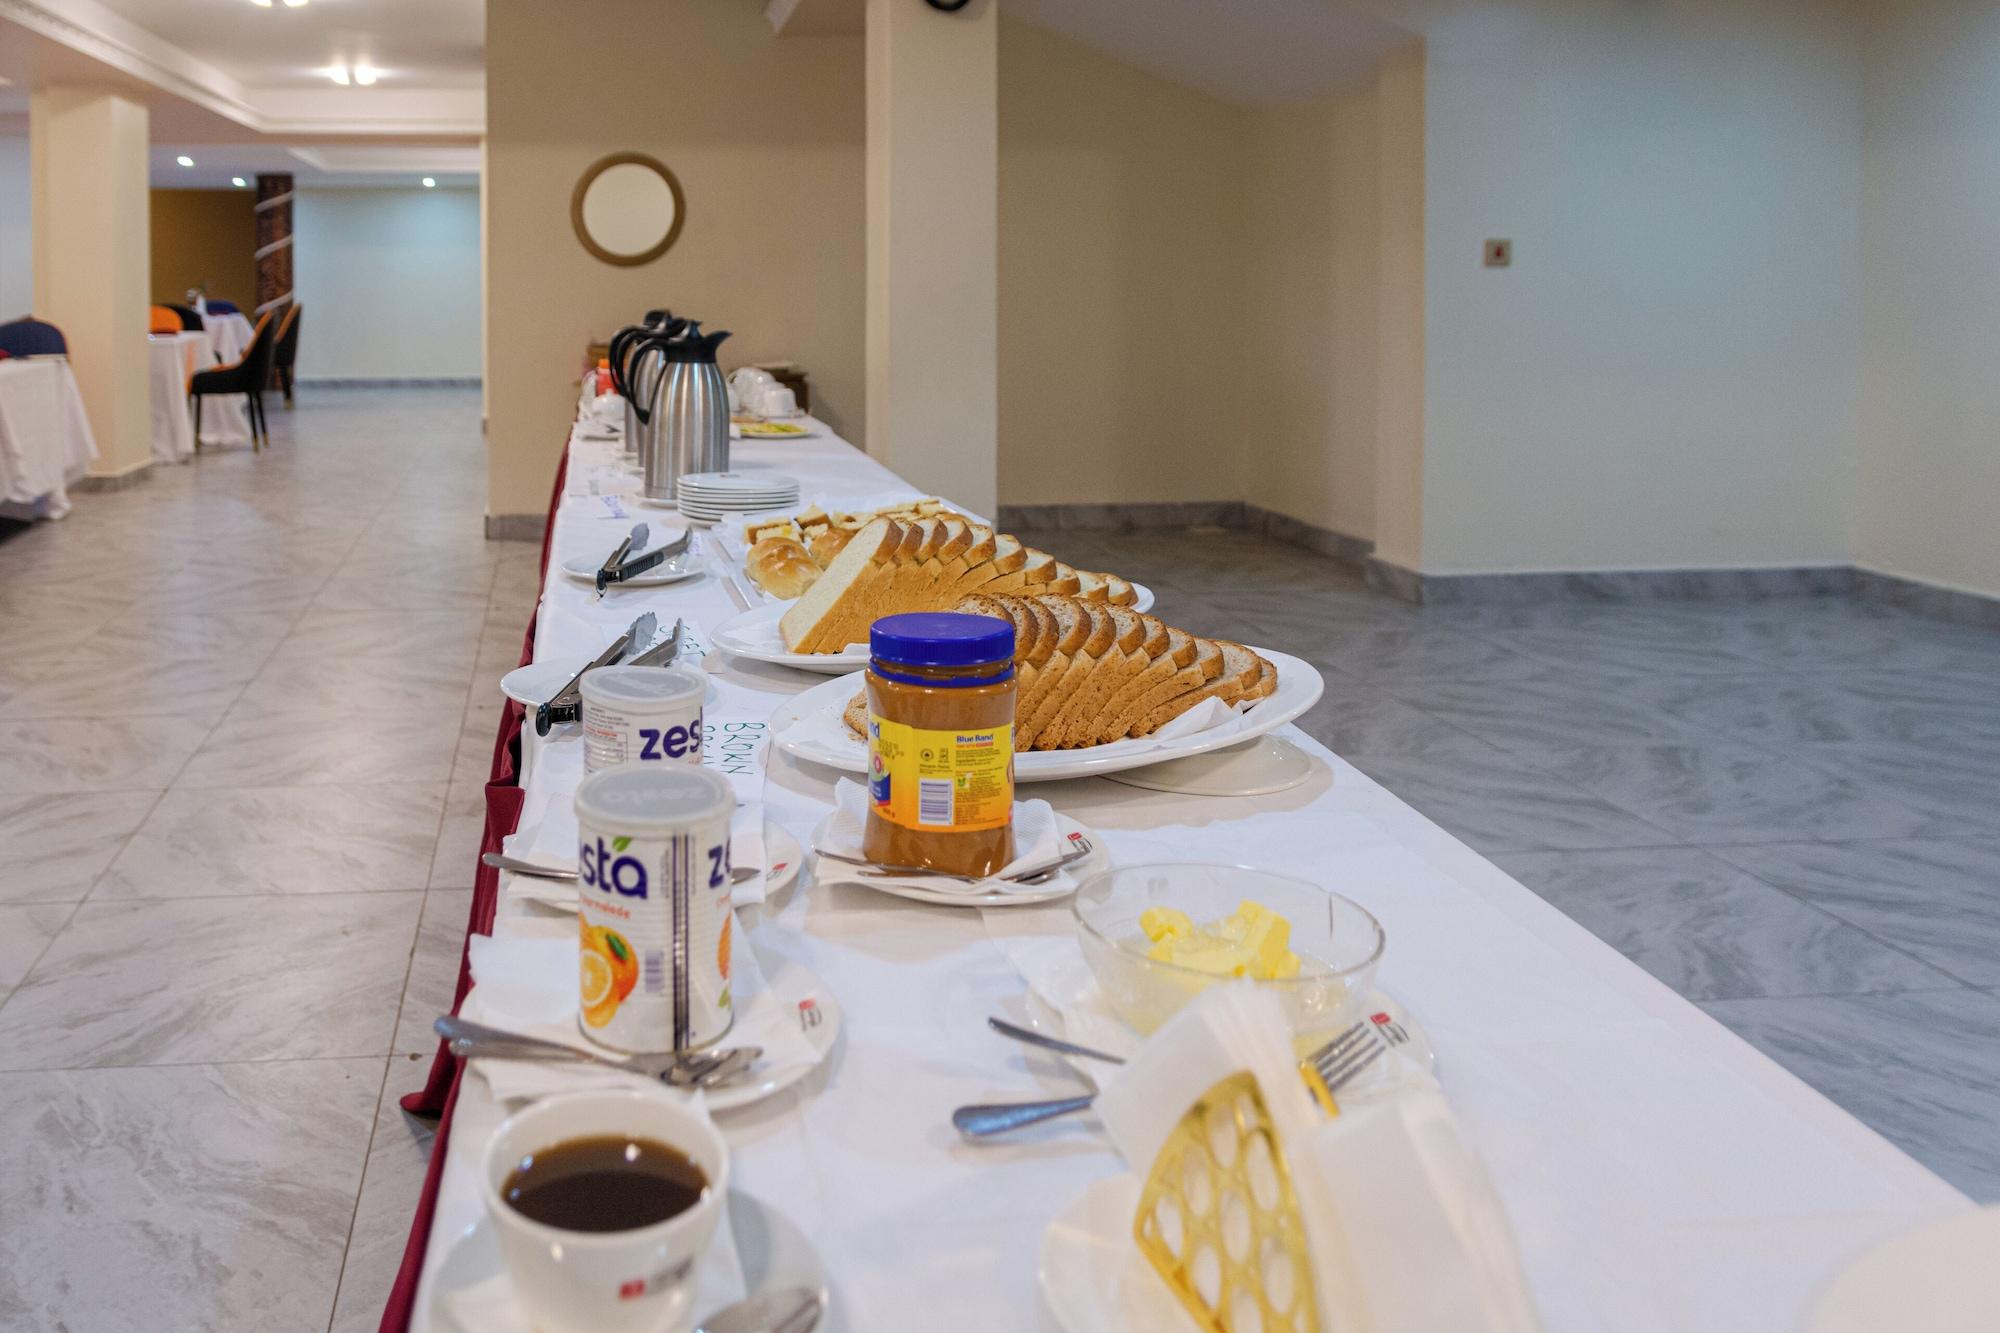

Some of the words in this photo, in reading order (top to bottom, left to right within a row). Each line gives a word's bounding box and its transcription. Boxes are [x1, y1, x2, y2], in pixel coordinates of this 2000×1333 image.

[638, 706, 703, 760] zes
[956, 735, 974, 743] Blue
[975, 732, 994, 743] Band
[580, 837, 648, 899] sta
